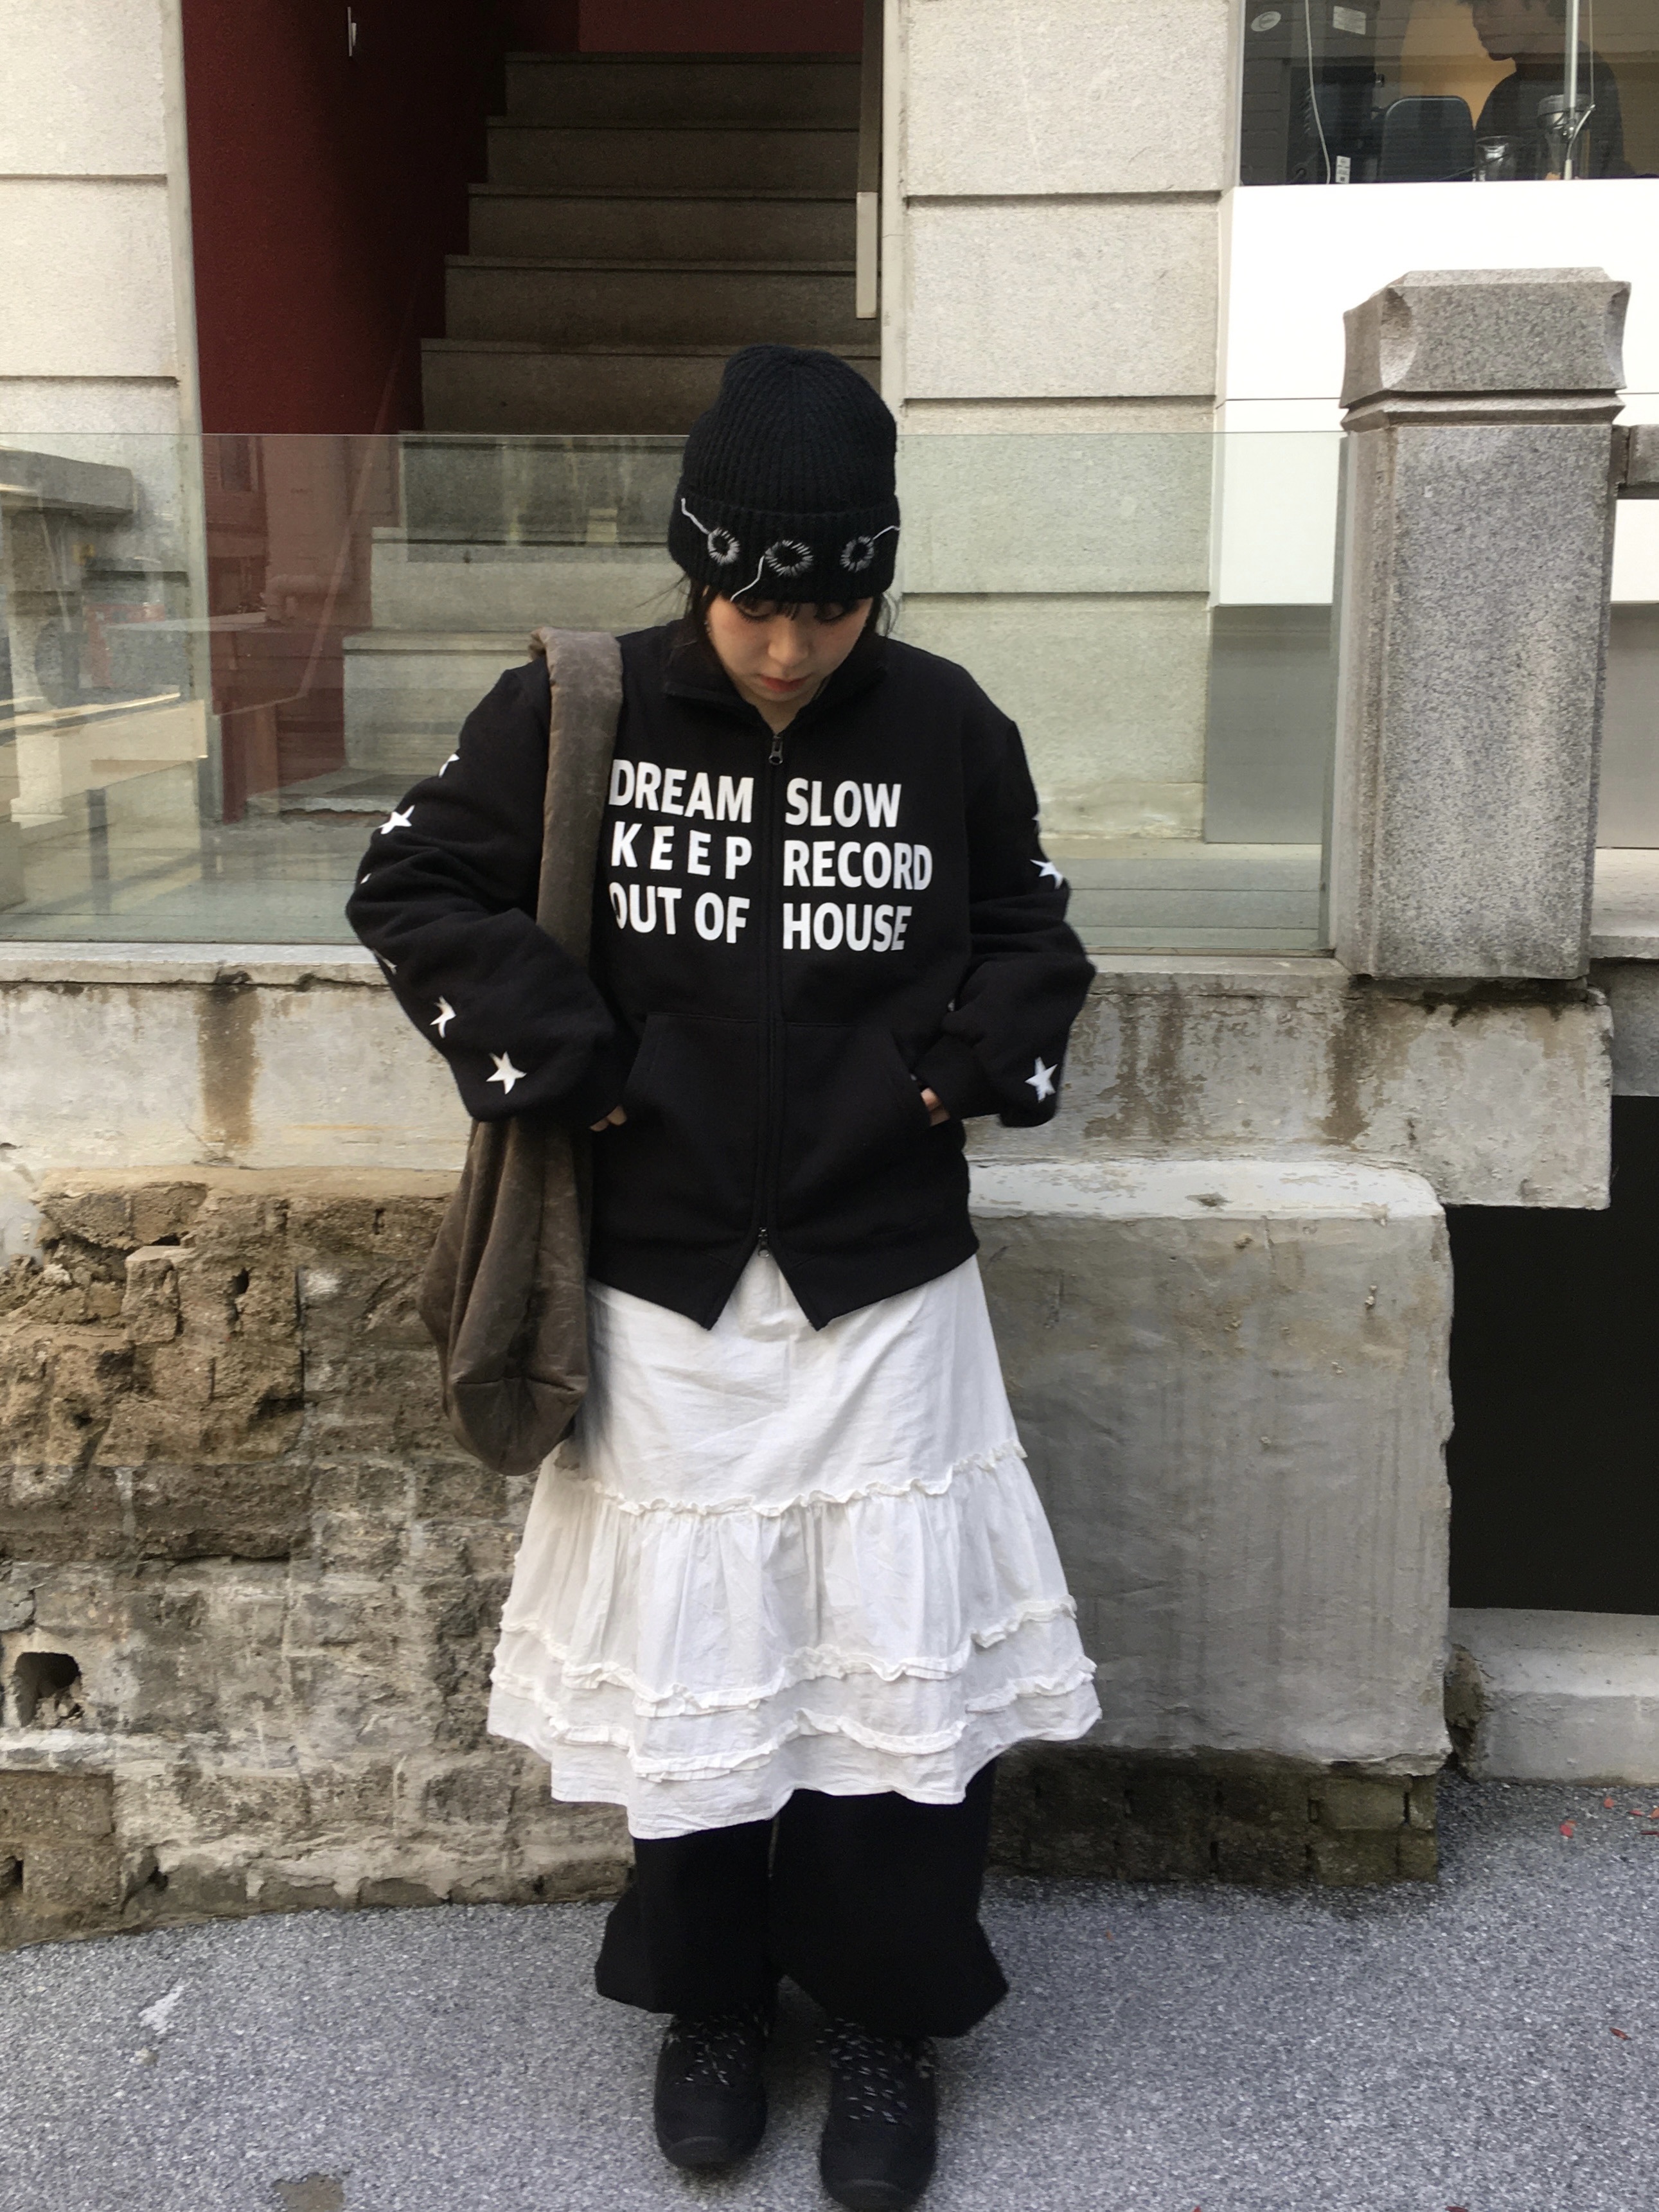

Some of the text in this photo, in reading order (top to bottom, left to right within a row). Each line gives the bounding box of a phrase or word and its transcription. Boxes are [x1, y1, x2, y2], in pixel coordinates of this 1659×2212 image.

[608, 759, 902, 828] DREAM SLOW
[611, 820, 933, 890] KEEP RECORD
[608, 881, 912, 952] OUT OF HOUSE
